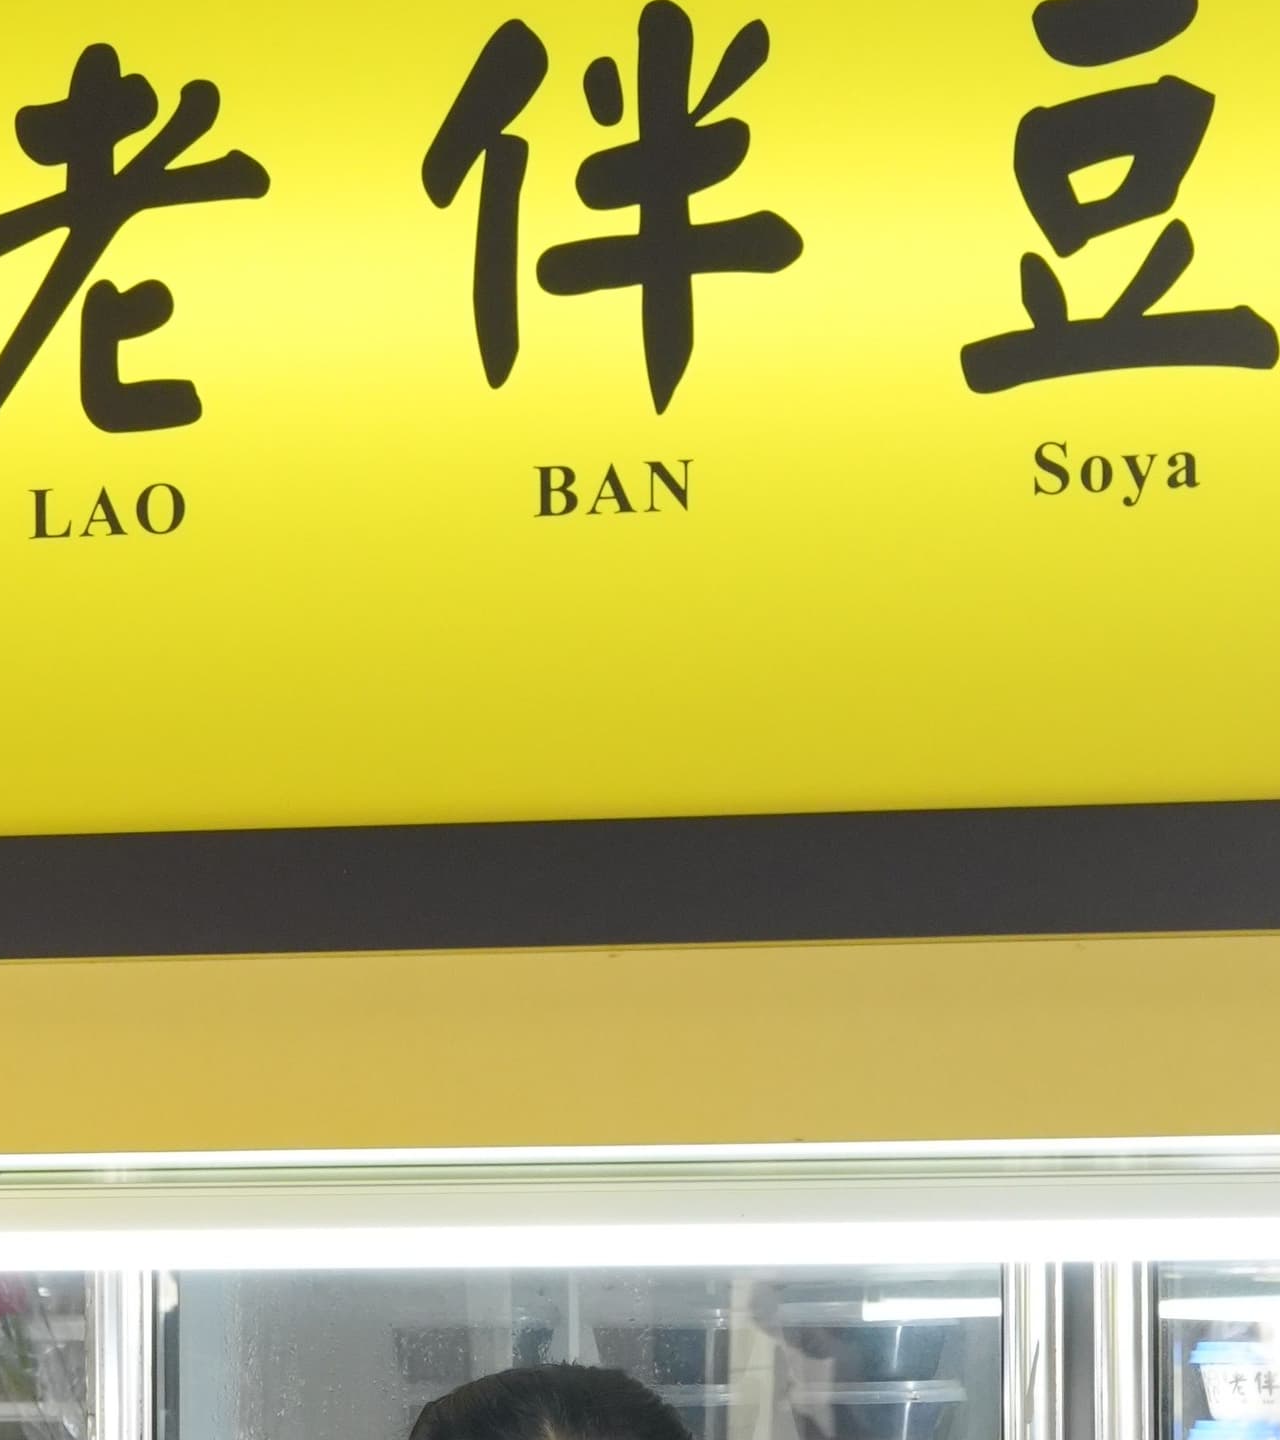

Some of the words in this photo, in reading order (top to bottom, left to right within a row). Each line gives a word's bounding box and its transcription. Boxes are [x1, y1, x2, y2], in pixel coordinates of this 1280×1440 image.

[28, 480, 190, 541] LAO
[533, 456, 695, 519] BAN
[1032, 439, 1201, 505] Soya
